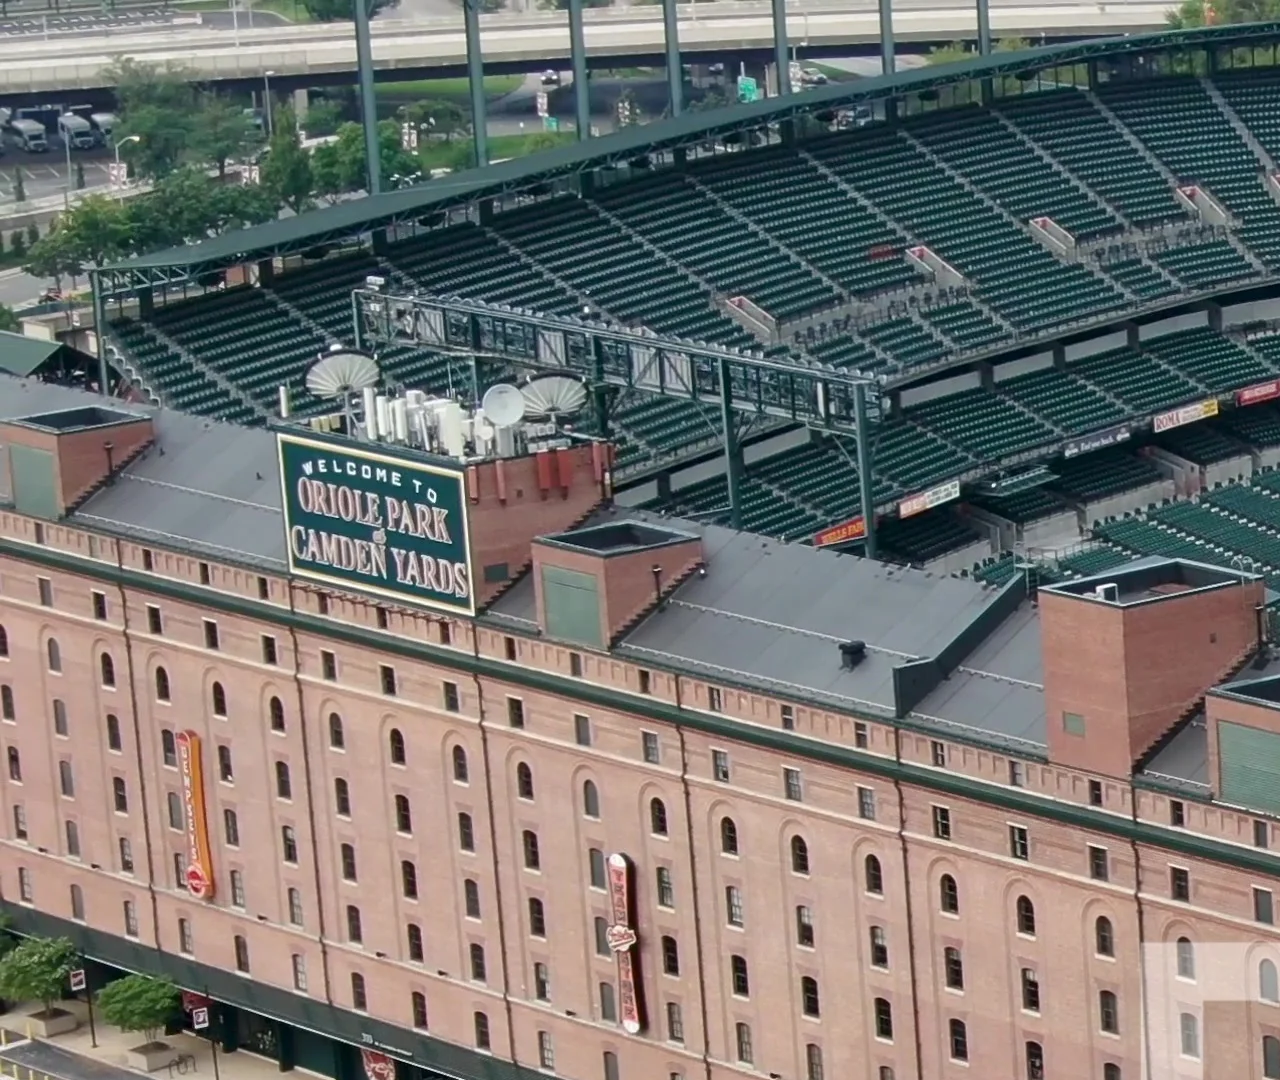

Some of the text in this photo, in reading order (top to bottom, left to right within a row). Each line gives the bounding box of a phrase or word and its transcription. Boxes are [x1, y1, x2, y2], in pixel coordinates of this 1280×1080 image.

[1156, 411, 1181, 431] ROMA
[302, 459, 438, 504] WELCOME TO
[297, 476, 453, 545] ORIOLE PARK
[291, 525, 469, 598] CAMDEN YARDS
